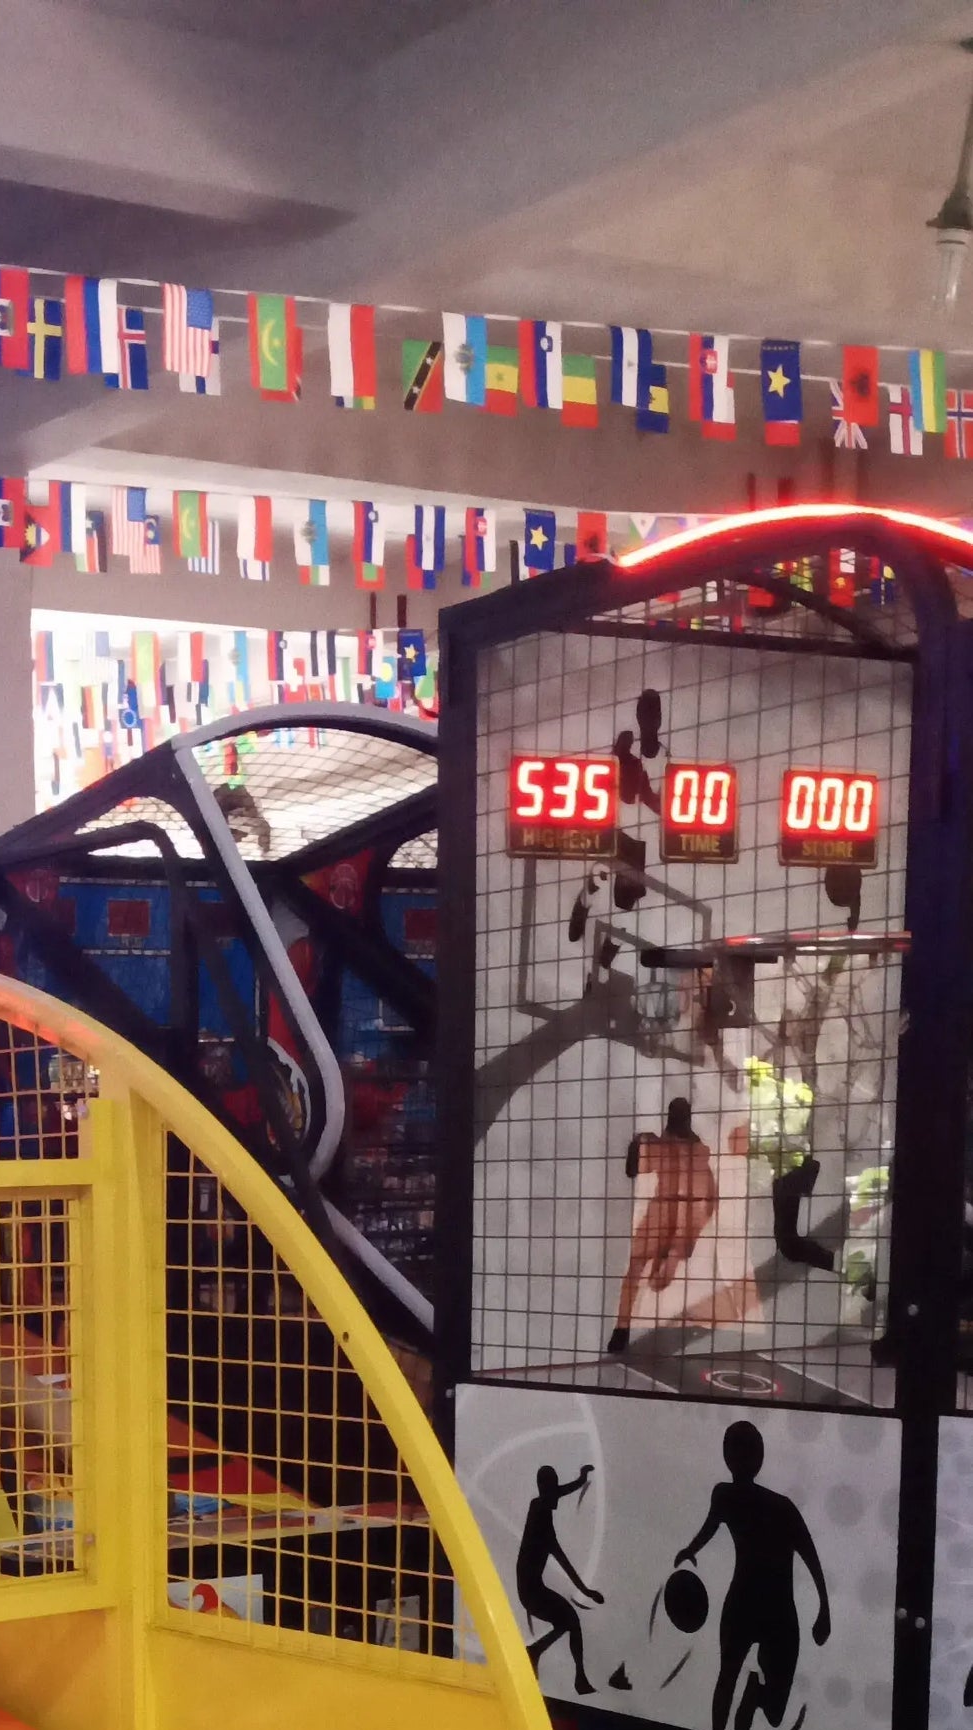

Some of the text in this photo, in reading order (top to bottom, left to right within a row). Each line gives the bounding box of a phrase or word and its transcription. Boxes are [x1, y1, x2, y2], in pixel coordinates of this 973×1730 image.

[515, 761, 610, 820] 535
[670, 770, 731, 824] 00
[785, 776, 873, 831] 000
[679, 833, 721, 853] TIME
